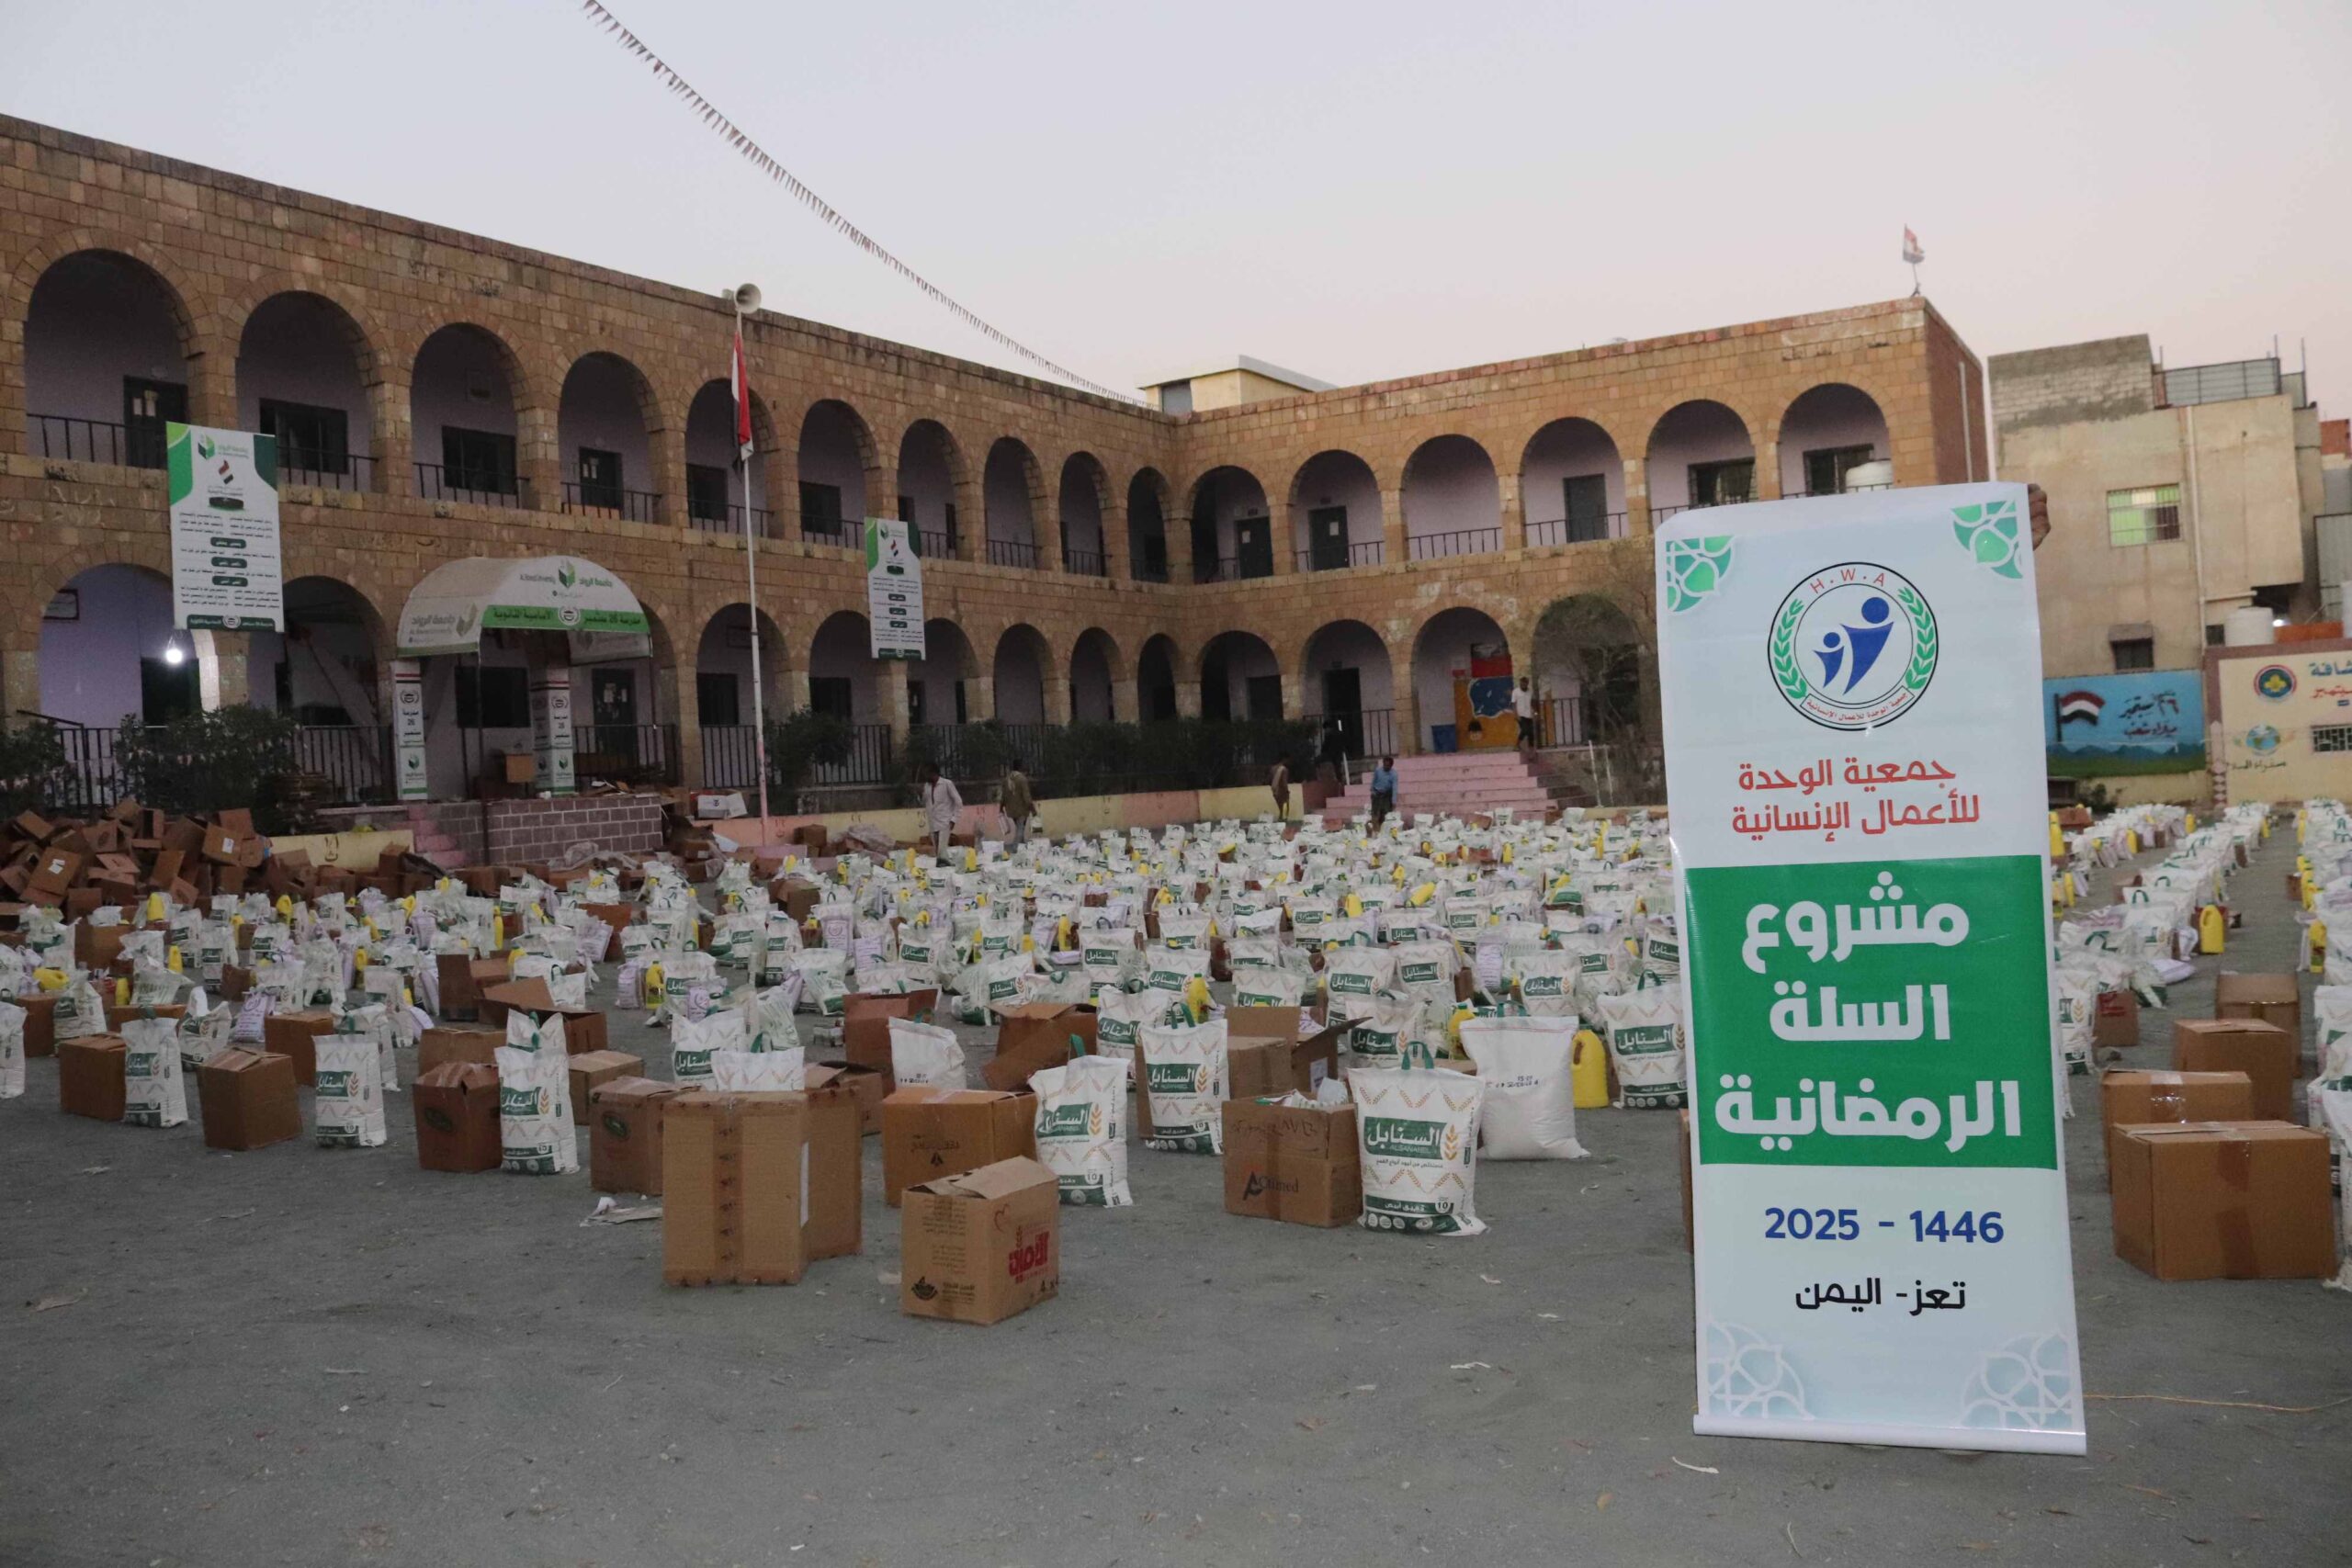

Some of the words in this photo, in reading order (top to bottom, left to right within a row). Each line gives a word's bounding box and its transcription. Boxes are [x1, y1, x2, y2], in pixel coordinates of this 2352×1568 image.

[1738, 759, 1834, 795] الوحدة
[1844, 757, 1956, 793] جمعية
[1732, 801, 1850, 842] الإنسانية
[1861, 788, 1981, 835] للأعمال
[1742, 871, 1970, 975] مشروع
[1770, 980, 1951, 1042] السلة
[1353, 1031, 1395, 1049] السنابل
[1617, 1029, 1671, 1050] السنابل
[1148, 1067, 1195, 1089] السنابل
[1715, 1074, 2021, 1153] الرمضانية
[1367, 1122, 1440, 1149] السنابل
[1437, 1201, 1449, 1210] 10
[1765, 1207, 1860, 1241] 2025
[1909, 1210, 2005, 1244] 1446
[1795, 1277, 1882, 1313] اليمن
